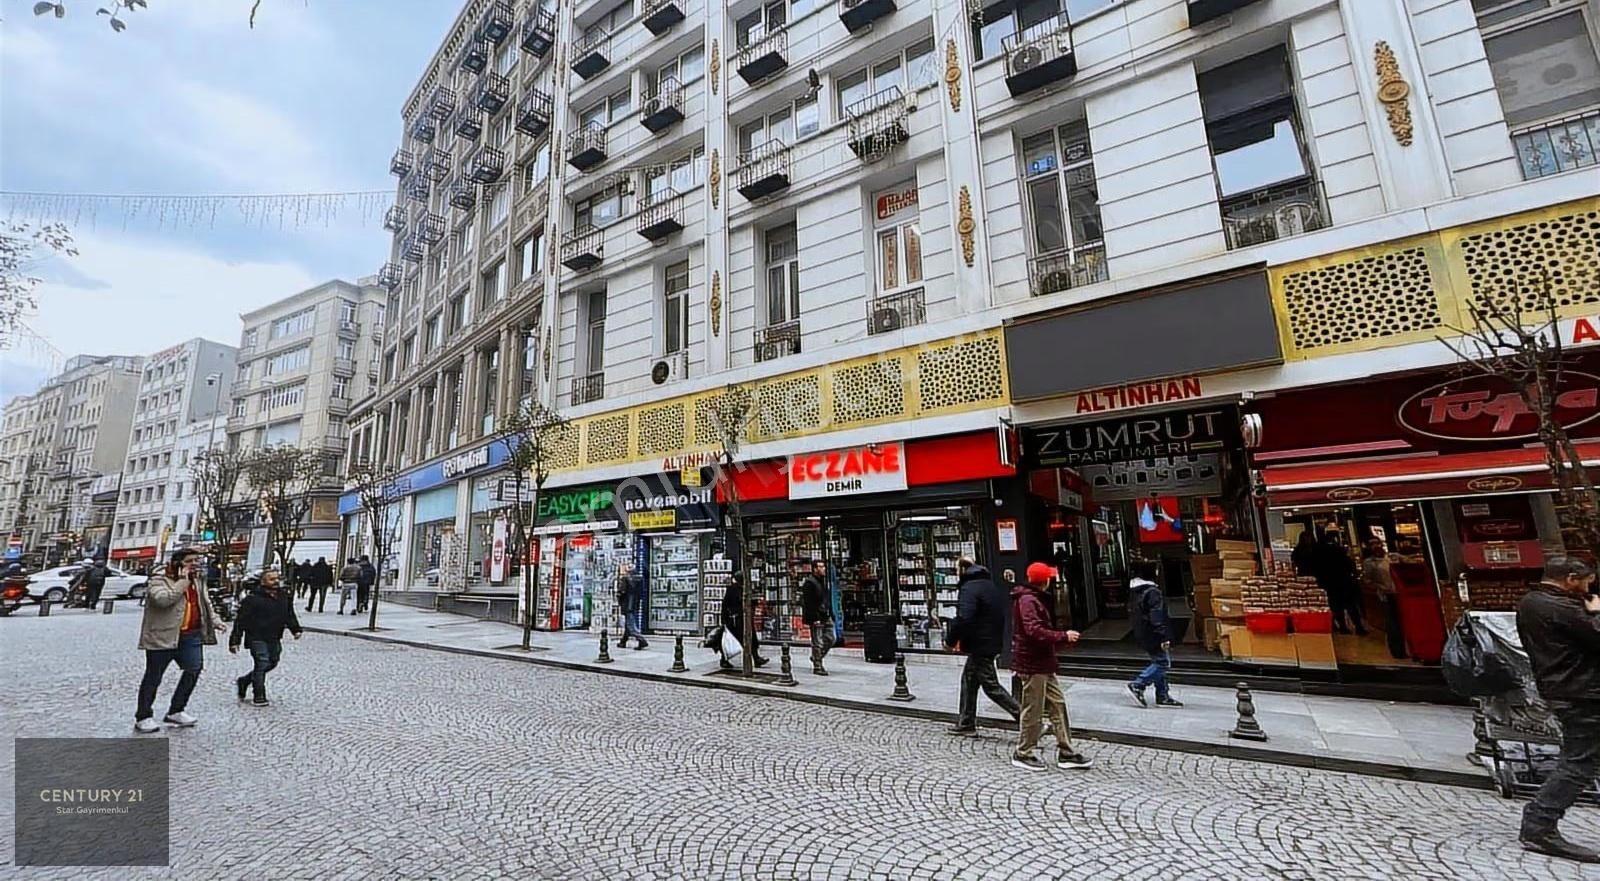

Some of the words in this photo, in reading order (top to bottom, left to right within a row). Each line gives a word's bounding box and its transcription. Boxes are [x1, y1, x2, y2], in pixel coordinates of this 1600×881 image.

[1076, 376, 1202, 414] ALTINHAN
[792, 442, 900, 483] ECZANE
[625, 489, 711, 511] novamobil
[826, 478, 863, 493] DEMİR
